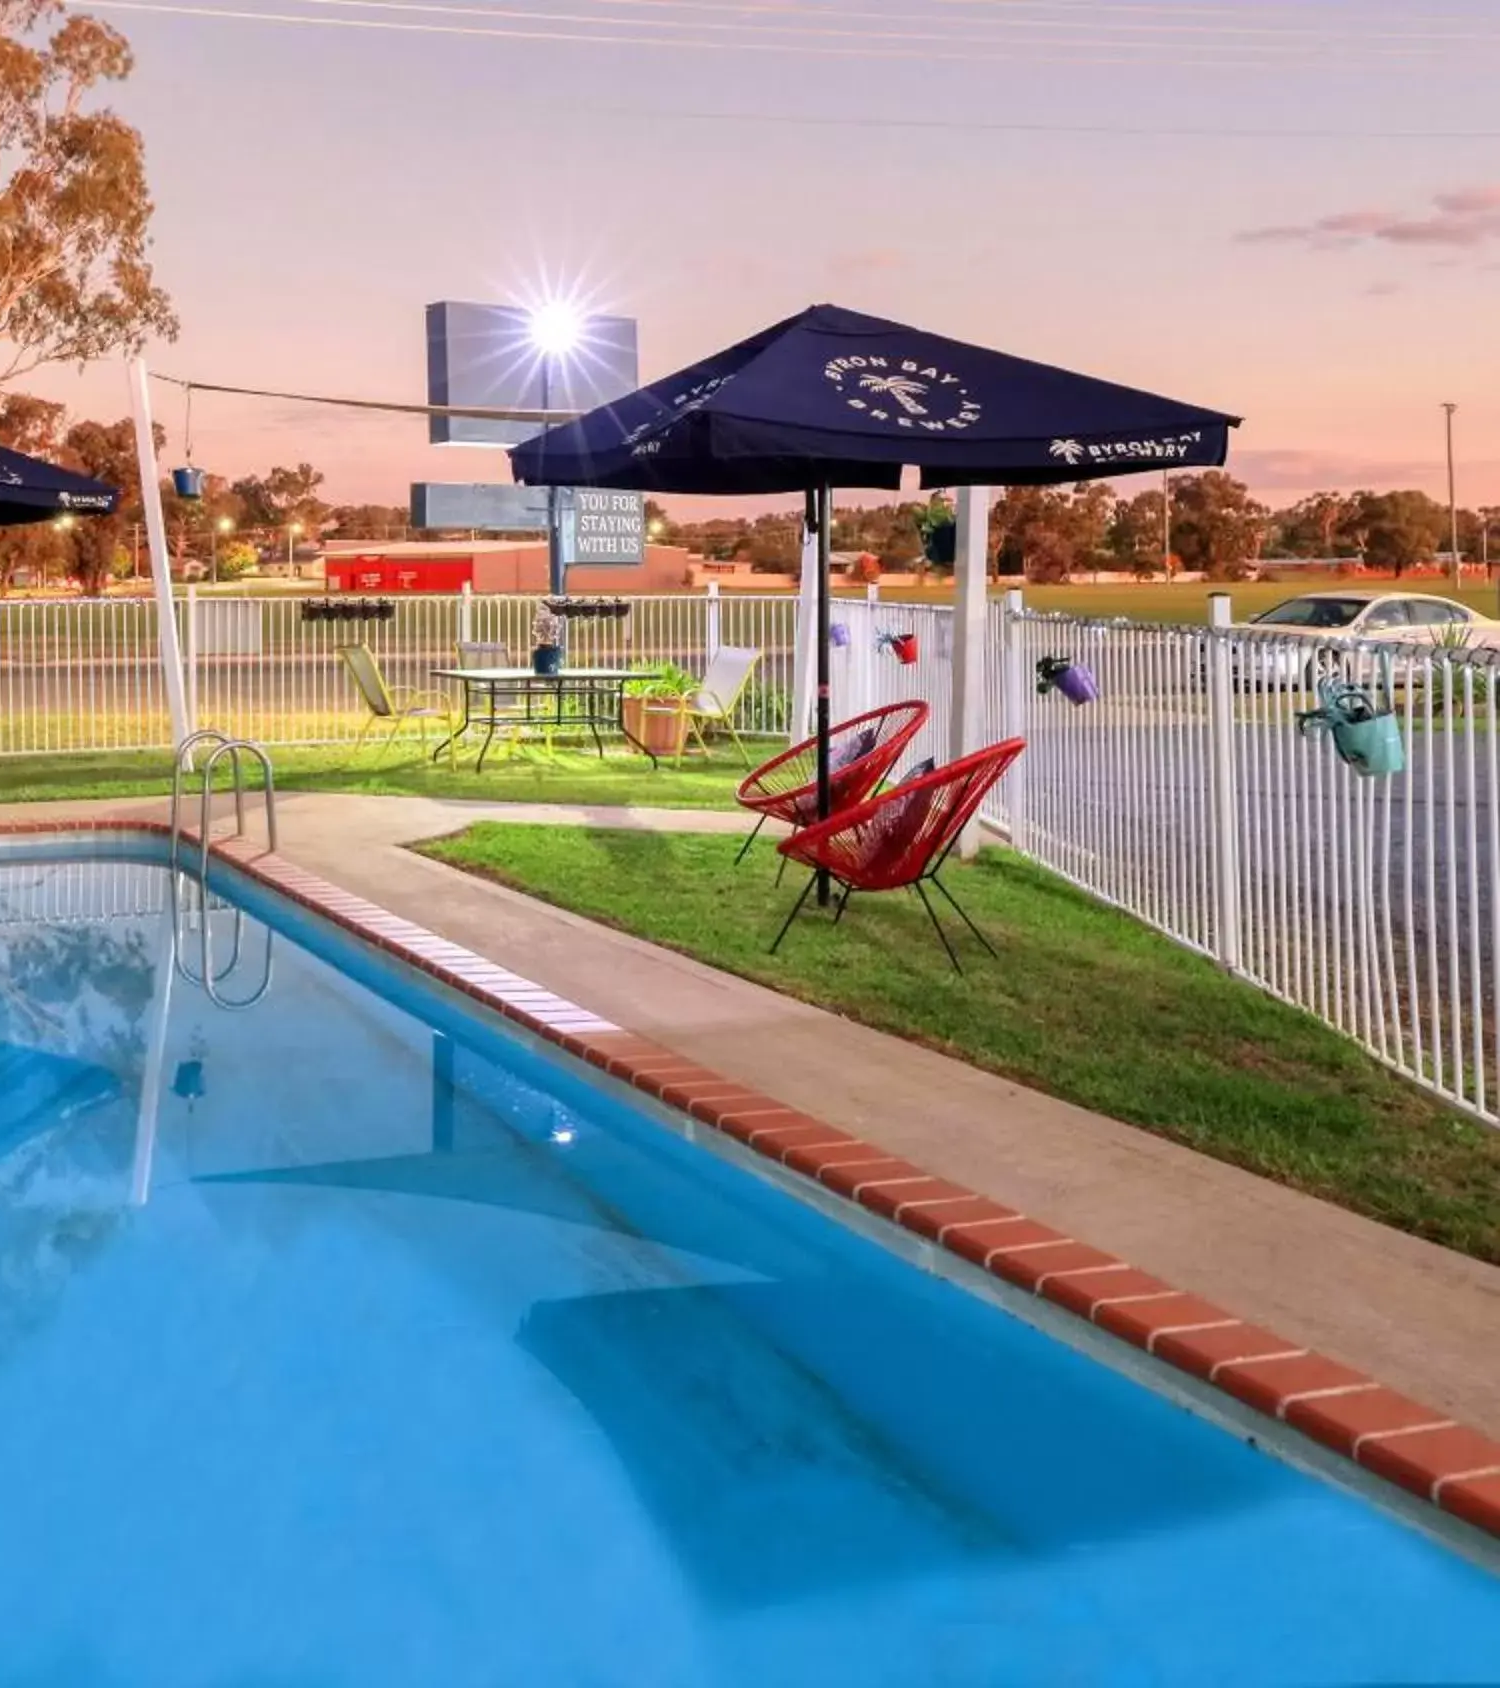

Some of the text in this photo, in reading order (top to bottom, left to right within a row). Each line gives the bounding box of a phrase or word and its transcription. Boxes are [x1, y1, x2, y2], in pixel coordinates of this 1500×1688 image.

[824, 355, 960, 384] BYRON BAY
[847, 399, 982, 431] BREWERY
[1088, 439, 1156, 457] BYRON
[579, 494, 639, 511] YOU FOR
[581, 515, 641, 533] STAYING
[578, 536, 639, 553] WITH US
